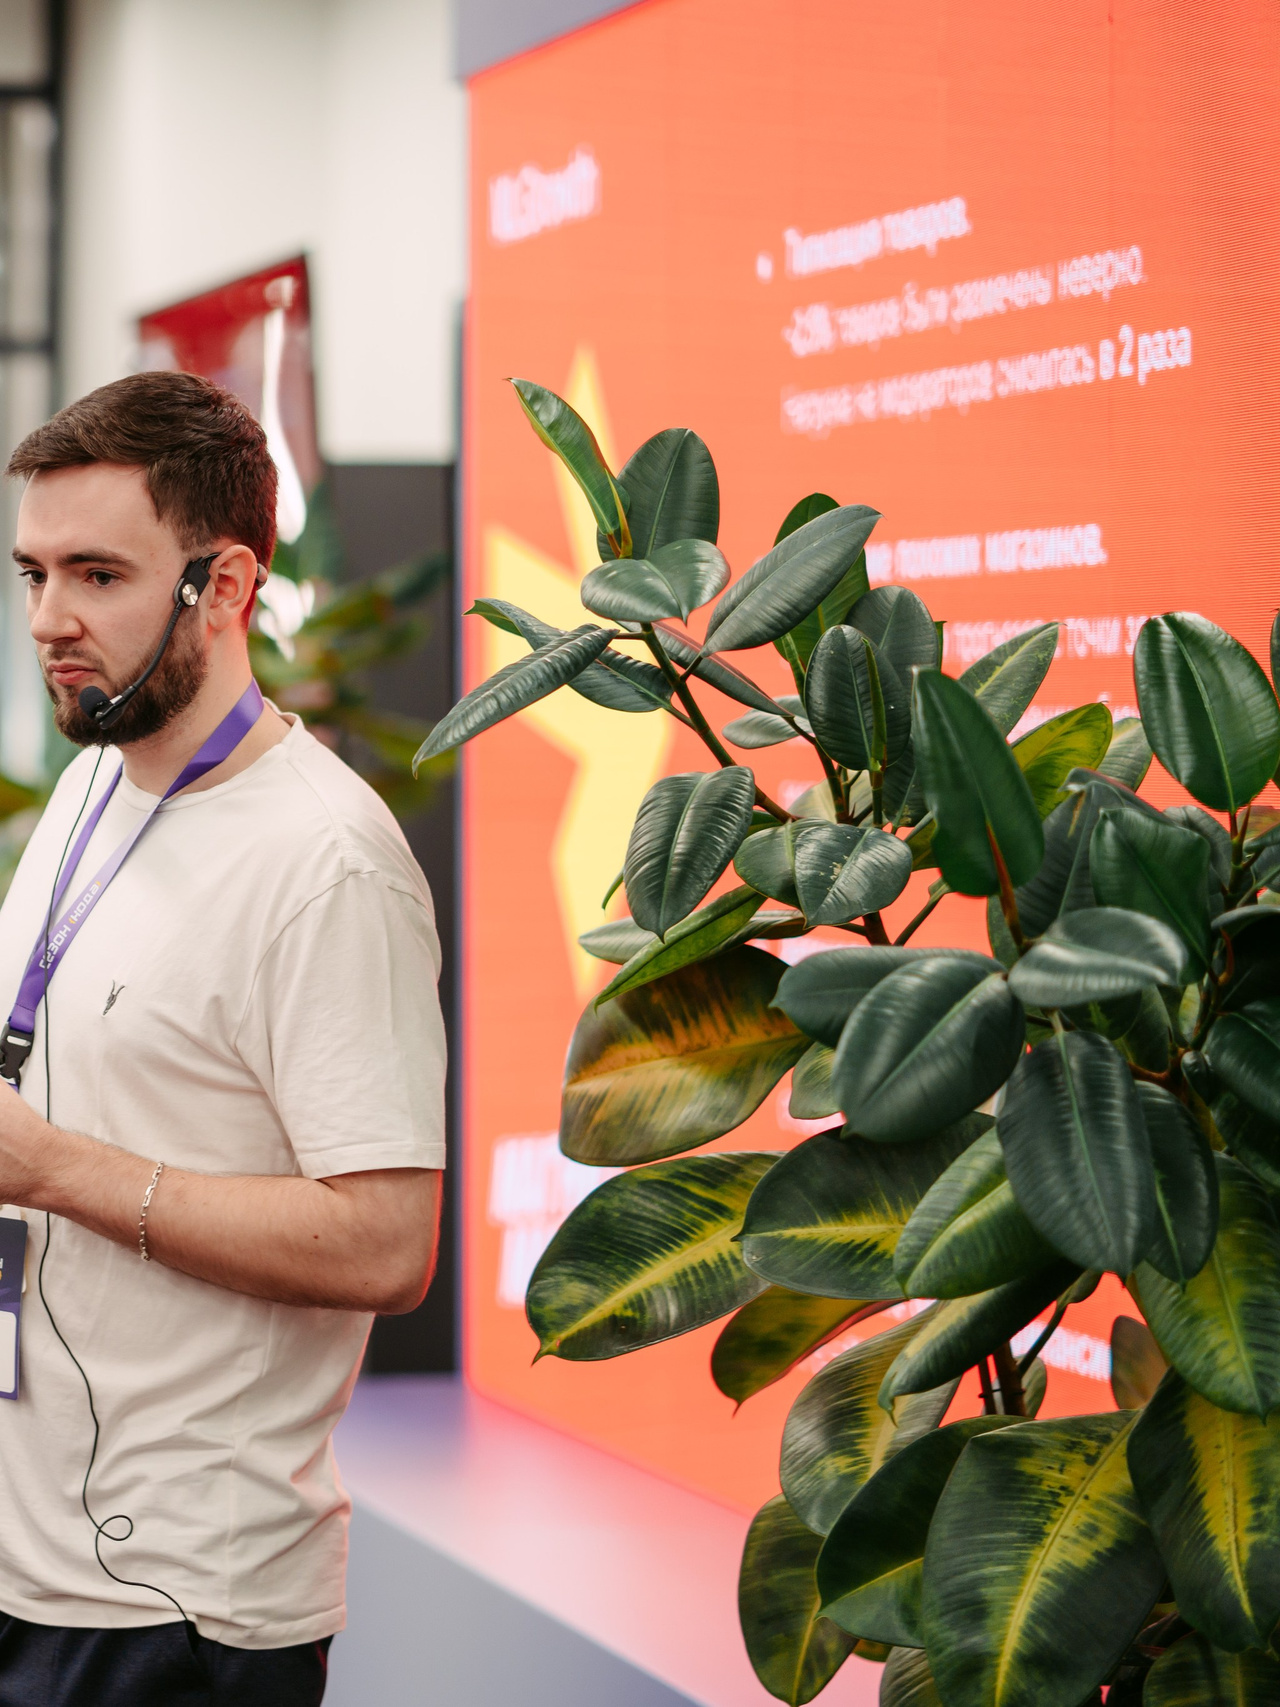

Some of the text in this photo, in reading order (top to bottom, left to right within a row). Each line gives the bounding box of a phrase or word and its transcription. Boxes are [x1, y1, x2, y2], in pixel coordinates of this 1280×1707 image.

[1099, 338, 1115, 381] в
[1118, 324, 1134, 377] 2
[1138, 326, 1192, 386] раза
